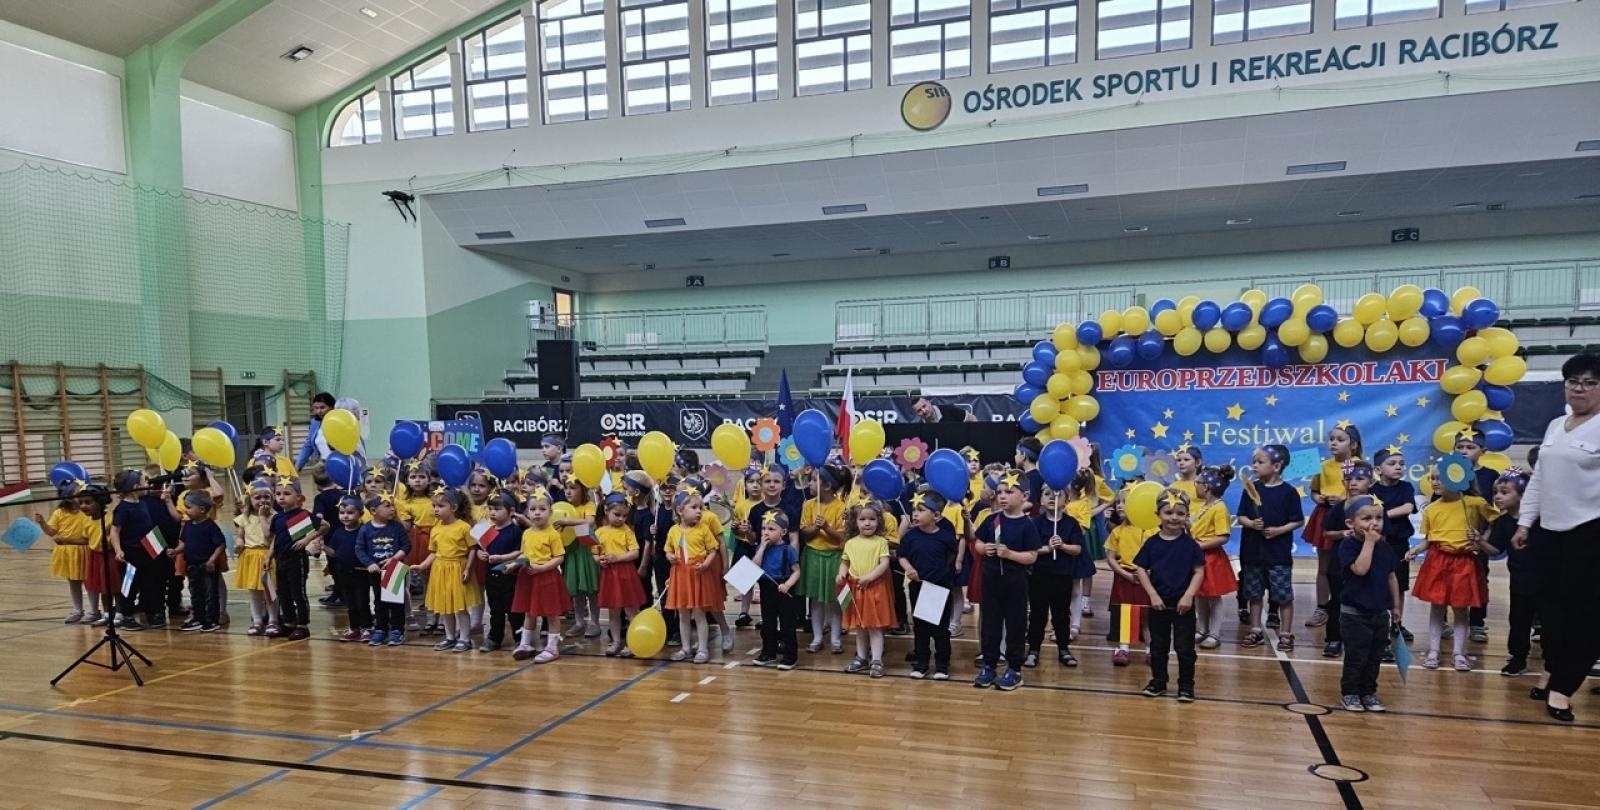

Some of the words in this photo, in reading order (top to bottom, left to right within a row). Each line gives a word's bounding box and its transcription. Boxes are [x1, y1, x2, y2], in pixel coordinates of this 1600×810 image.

[963, 77, 1083, 114] OŚRODEK
[1092, 63, 1200, 100] SPORTU
[1211, 61, 1217, 86] I
[1229, 41, 1386, 83] REKREACJI
[1399, 22, 1559, 65] RACIBÓRZ
[1096, 359, 1449, 392] EUROPRZEDSZKOLAKI
[1202, 420, 1326, 446] Festiwal
